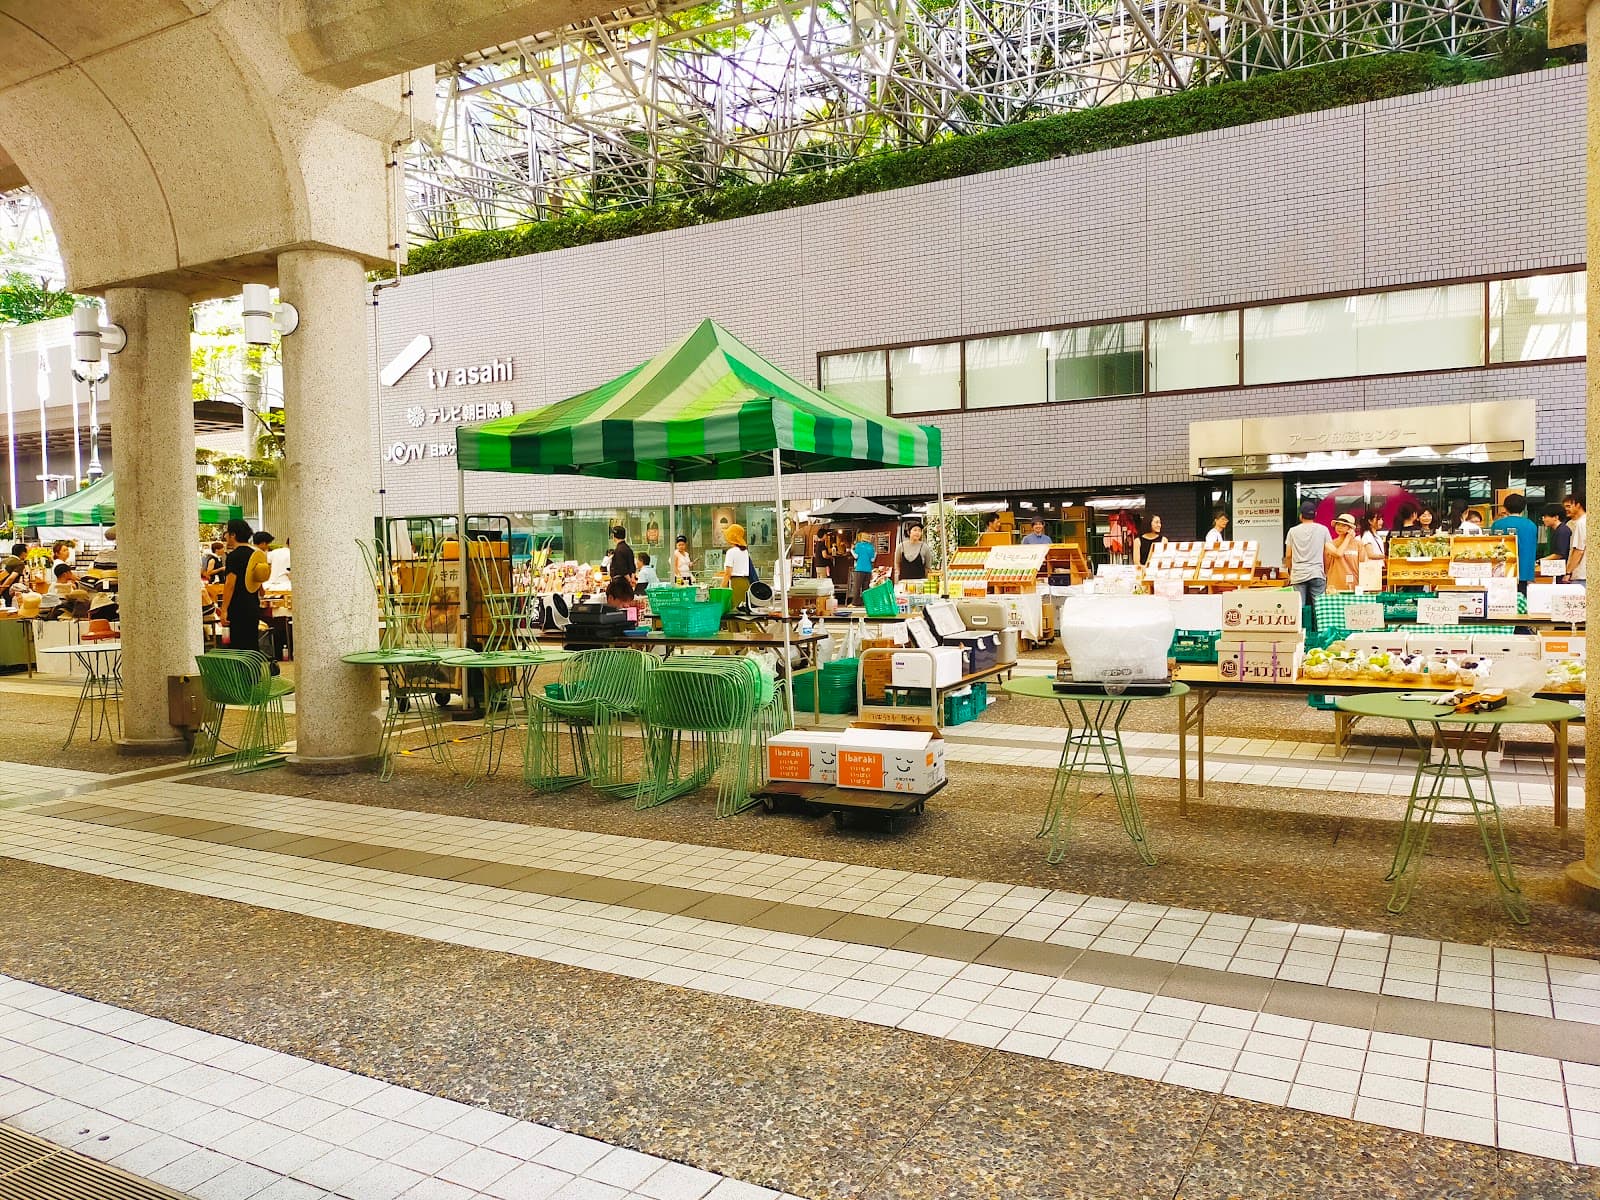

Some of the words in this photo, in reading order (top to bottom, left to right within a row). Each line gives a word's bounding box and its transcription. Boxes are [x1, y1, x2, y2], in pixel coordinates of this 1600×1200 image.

[428, 367, 450, 389] tv
[455, 357, 514, 386] asahi
[429, 401, 514, 424] テレビ朝日映像
[1288, 429, 1417, 446] アーク放送センター
[775, 748, 803, 758] Ibaraki
[845, 753, 876, 764] Ibaraki
